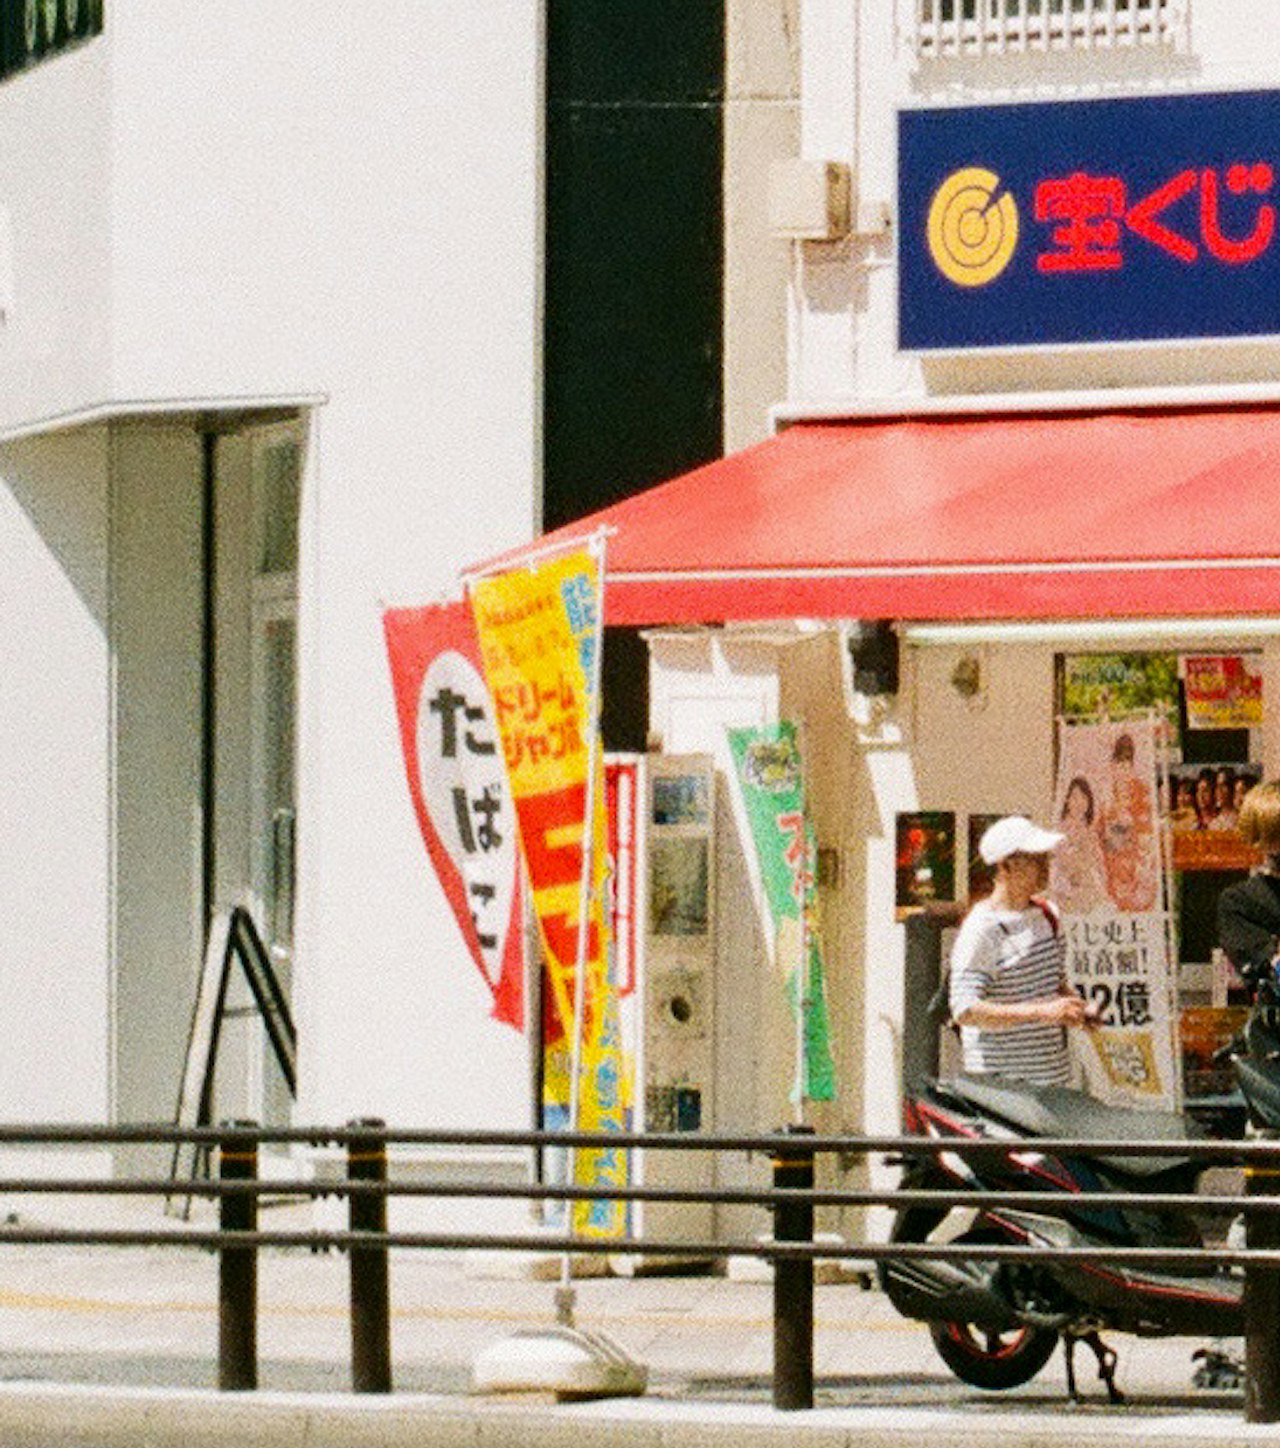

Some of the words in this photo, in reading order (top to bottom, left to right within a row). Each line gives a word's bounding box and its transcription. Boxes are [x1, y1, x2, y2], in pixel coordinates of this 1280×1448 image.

[1033, 164, 1277, 274] 宝くじ
[429, 686, 503, 950] たばこ
